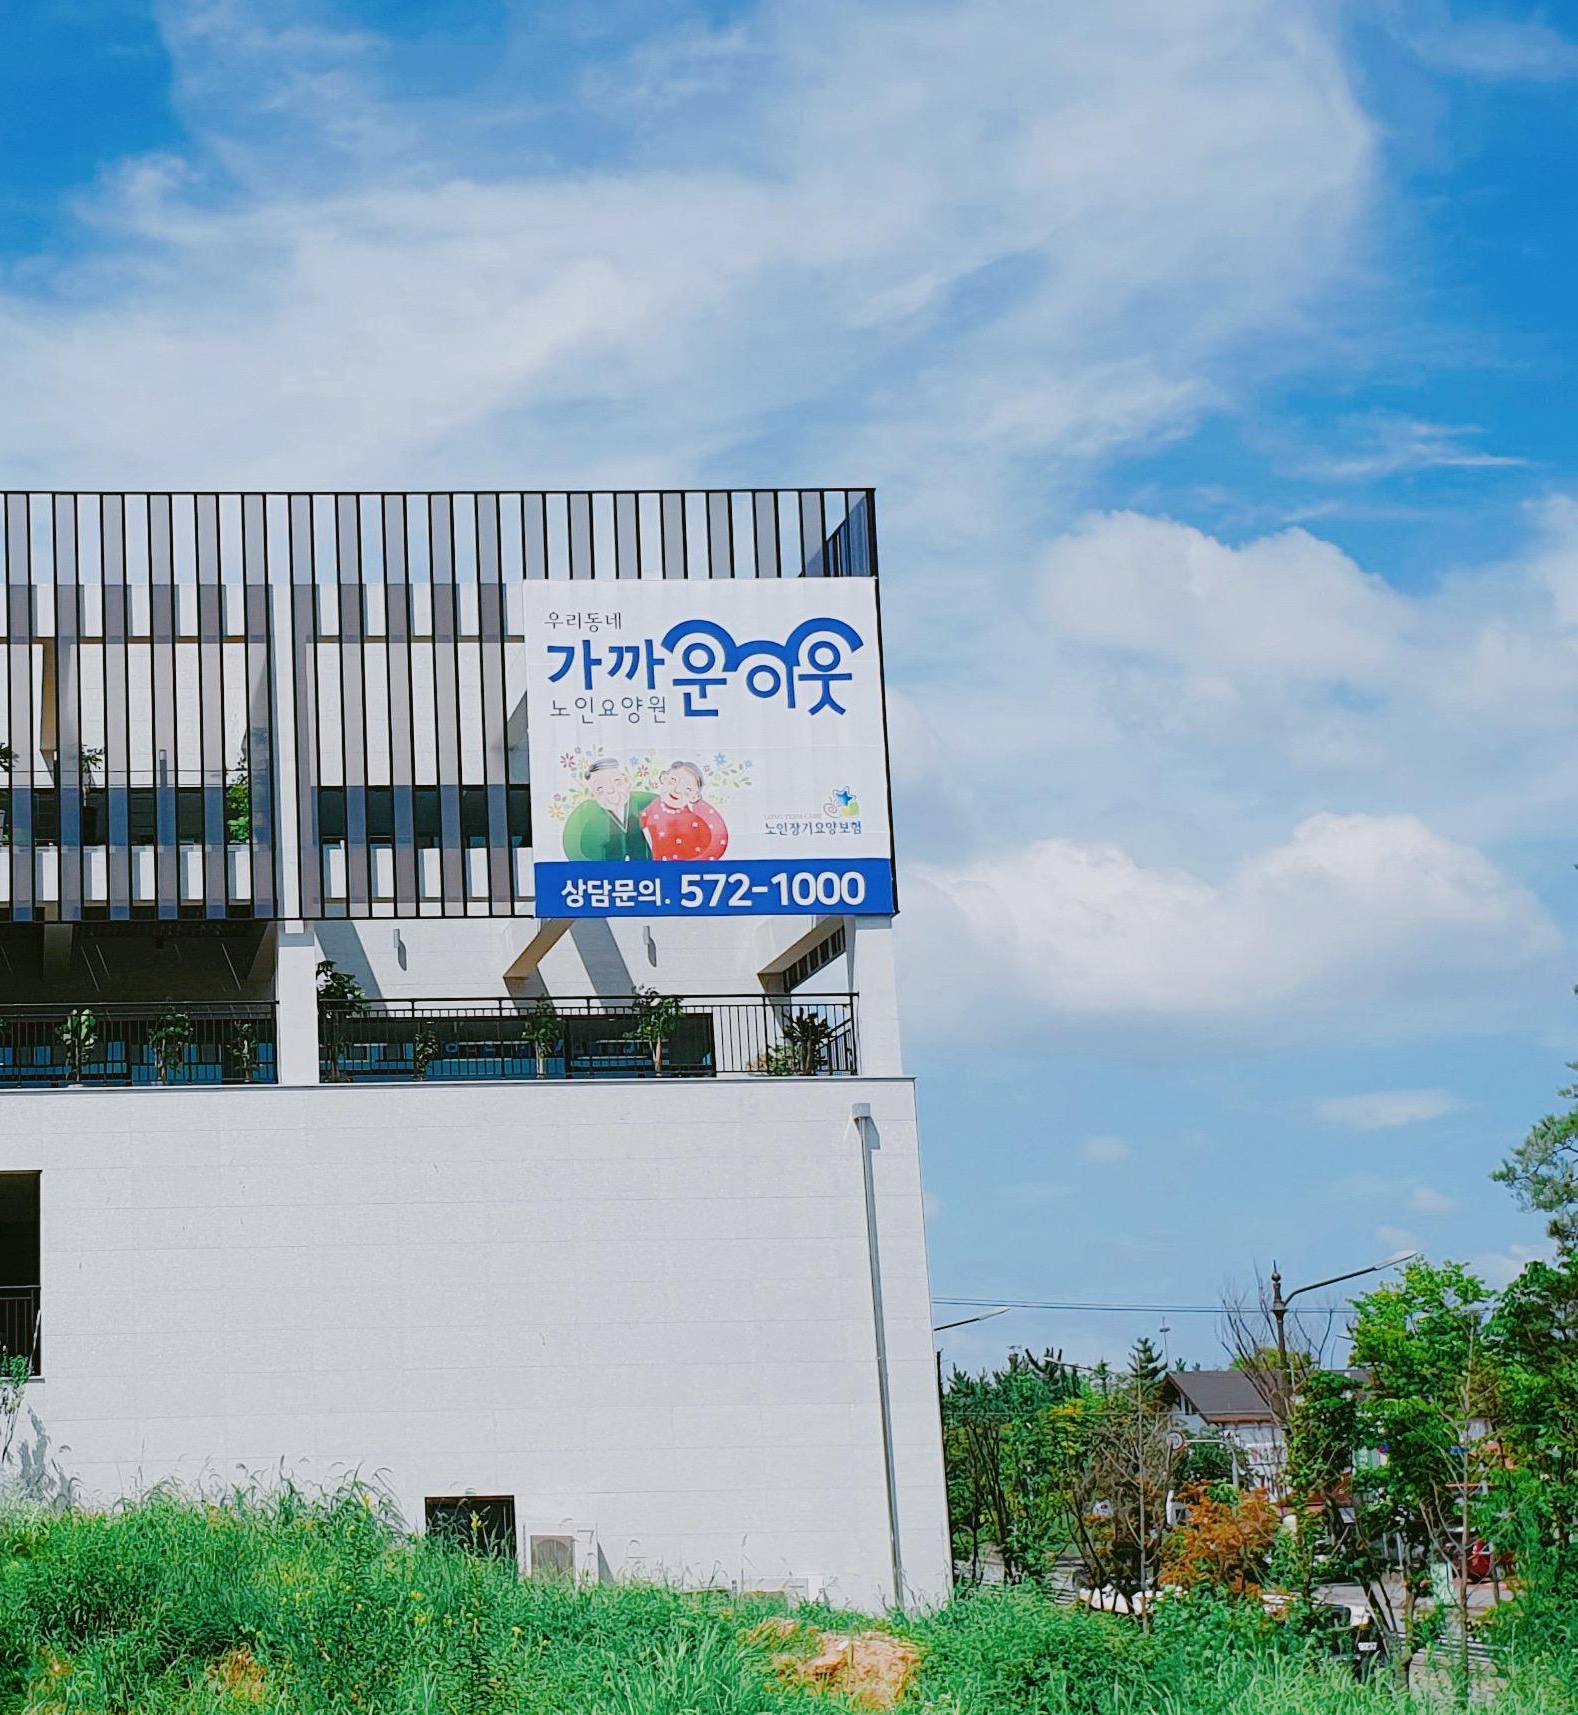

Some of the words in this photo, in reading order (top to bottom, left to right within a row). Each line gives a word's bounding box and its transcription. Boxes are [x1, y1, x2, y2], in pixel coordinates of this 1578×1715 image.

[544, 611, 622, 633] 우리동네
[550, 696, 666, 724] 노인요양원
[763, 820, 862, 836] 노인장기요양보험
[679, 871, 866, 908] 572-1000
